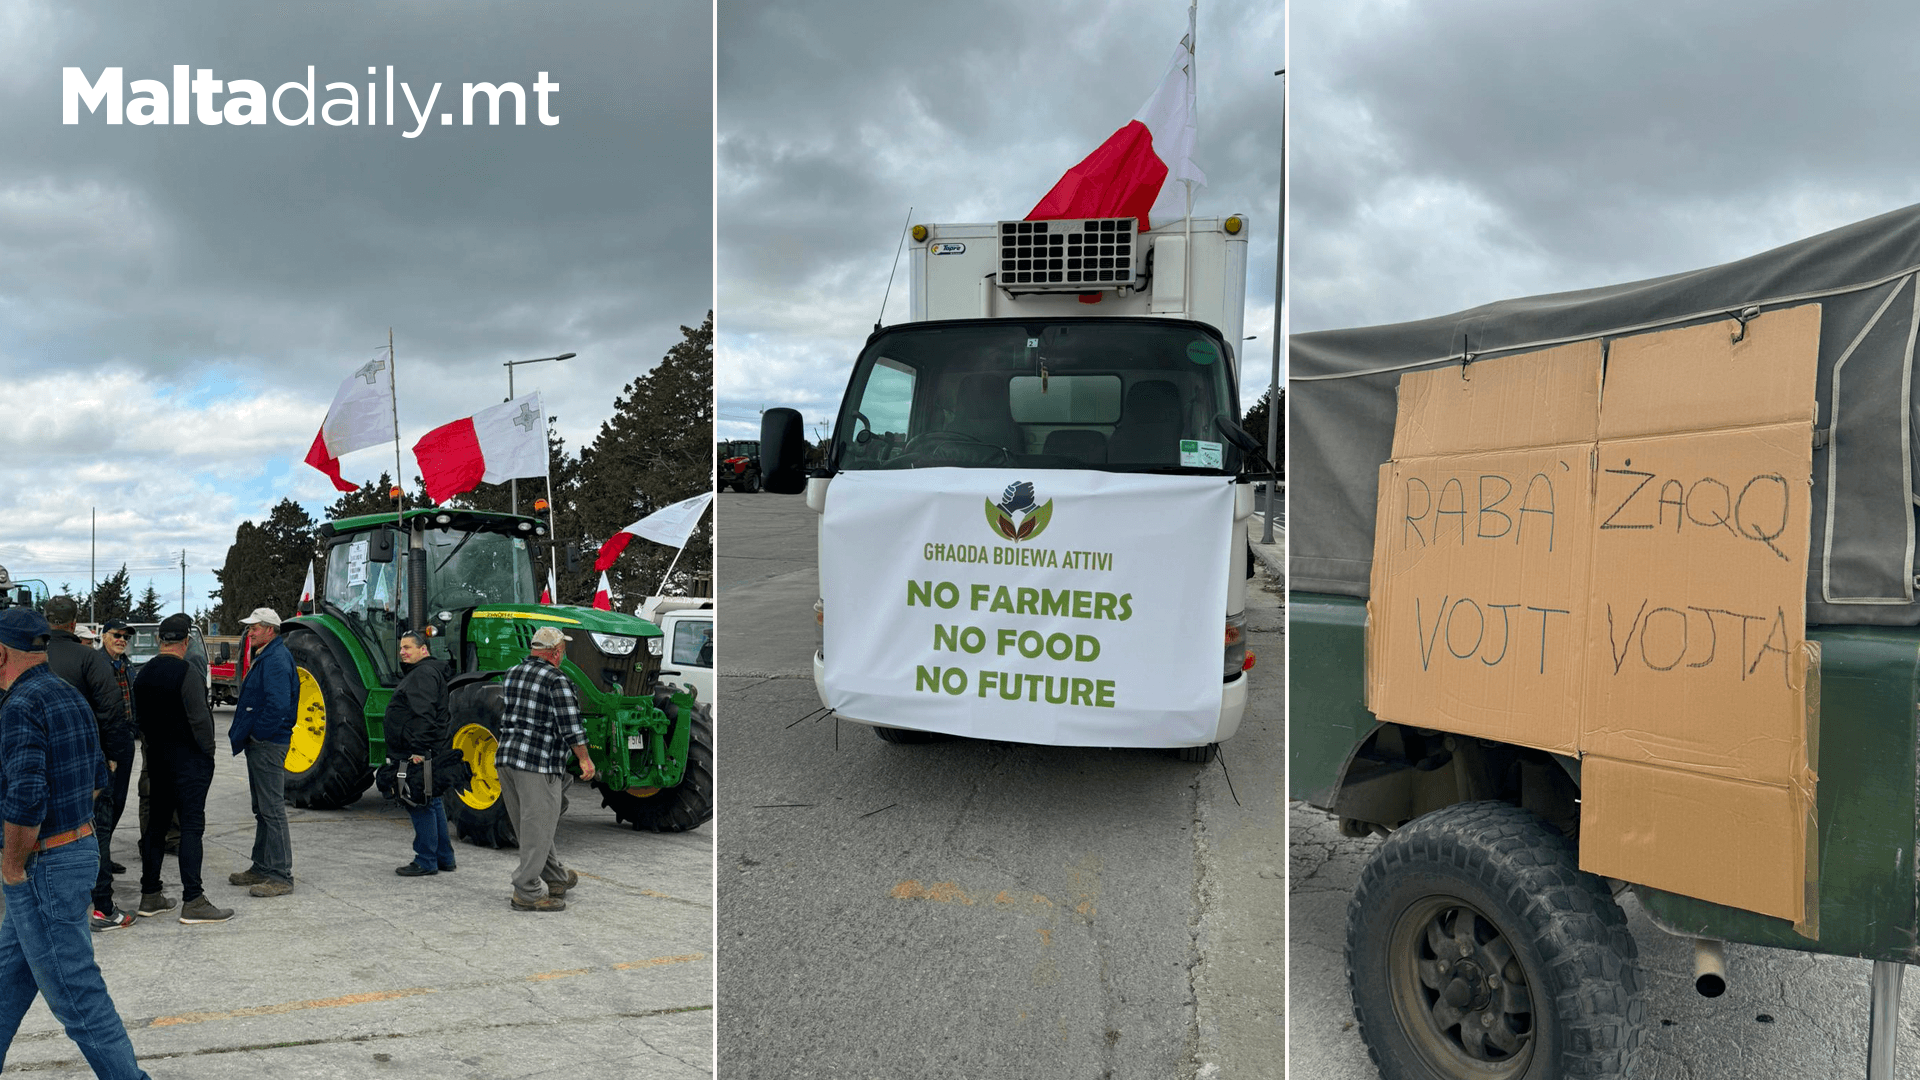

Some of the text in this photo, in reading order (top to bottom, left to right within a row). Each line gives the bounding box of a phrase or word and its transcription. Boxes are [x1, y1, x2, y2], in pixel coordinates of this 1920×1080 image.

[924, 542, 1114, 572] GĦAQDA BDIEWA ATTIVI
[907, 579, 1133, 622] NO FARMERS
[933, 623, 1101, 663] NO FOOD
[1416, 595, 1570, 675] VOJT
[1606, 598, 1792, 690] VOJTA
[915, 664, 1116, 709] NO FUTURE
